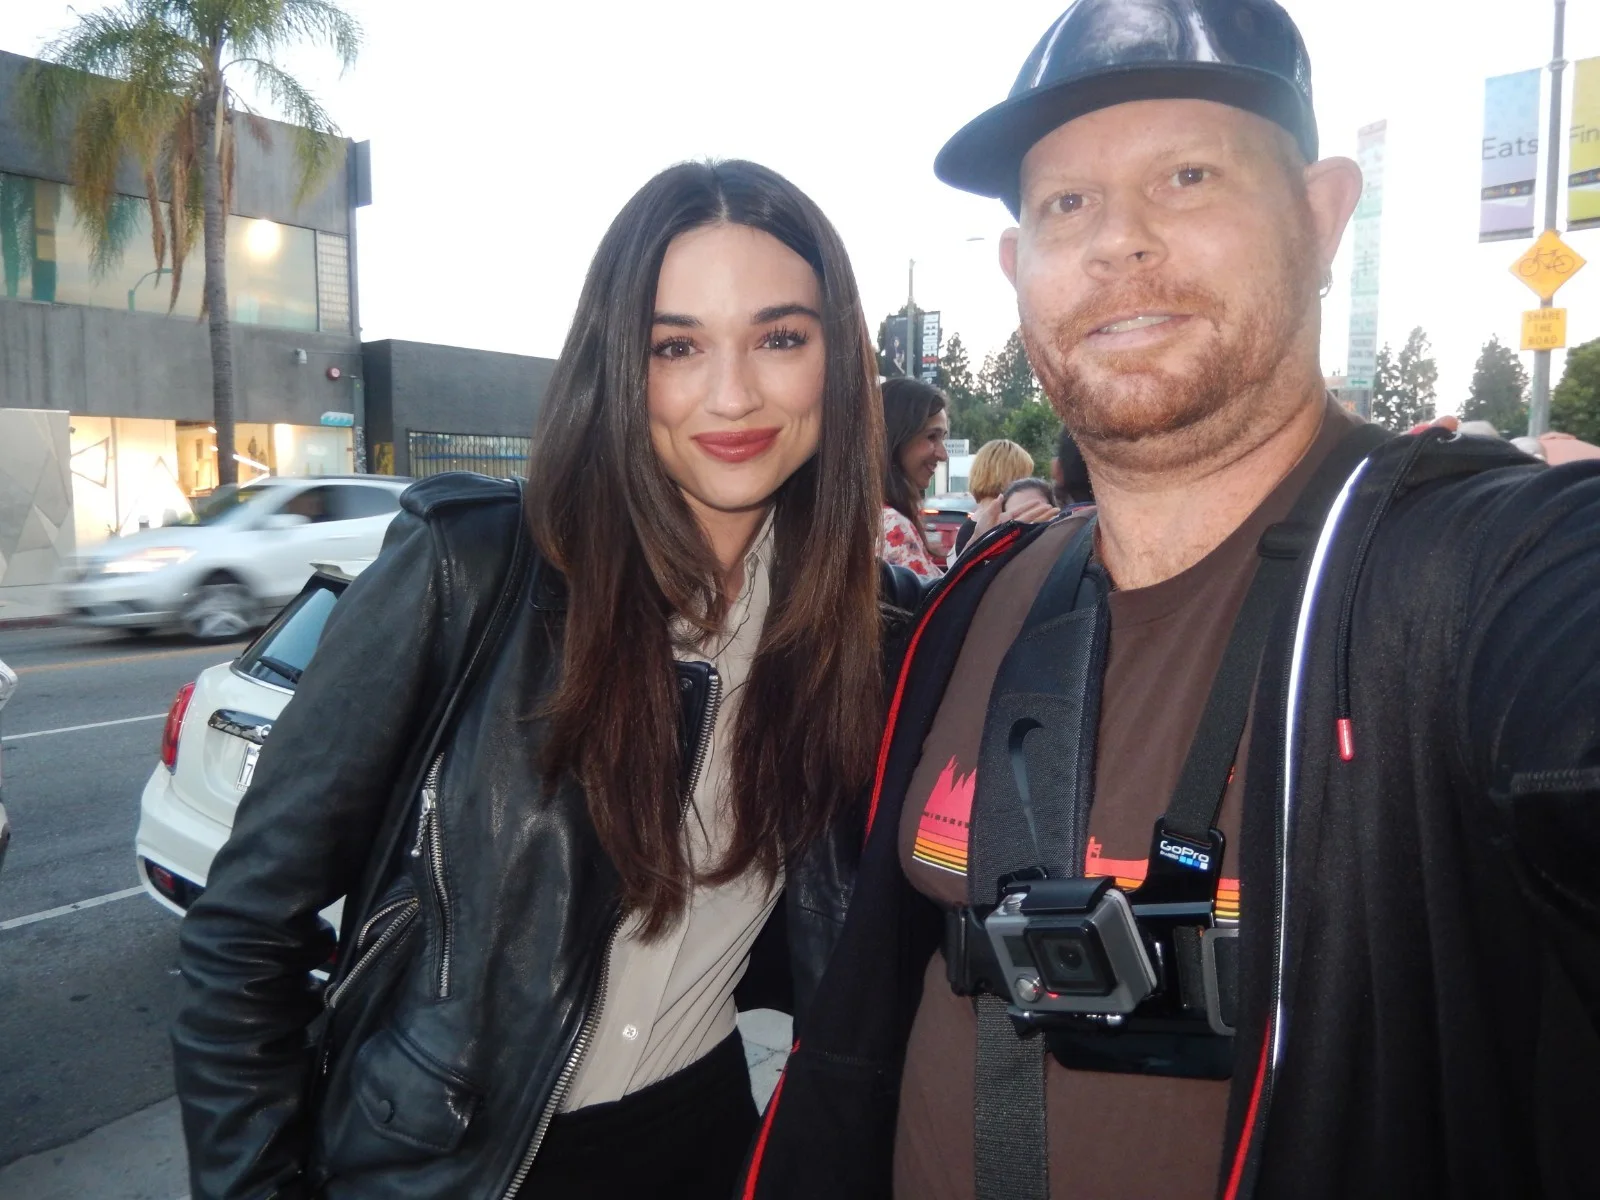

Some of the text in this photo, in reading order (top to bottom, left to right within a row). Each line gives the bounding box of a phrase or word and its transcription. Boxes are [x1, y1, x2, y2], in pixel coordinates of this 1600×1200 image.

[1482, 137, 1539, 160] Eats
[1527, 310, 1561, 322] SHARE
[1534, 323, 1552, 333] THE
[1527, 334, 1558, 345] ROAD
[1160, 840, 1210, 863] GoPro
